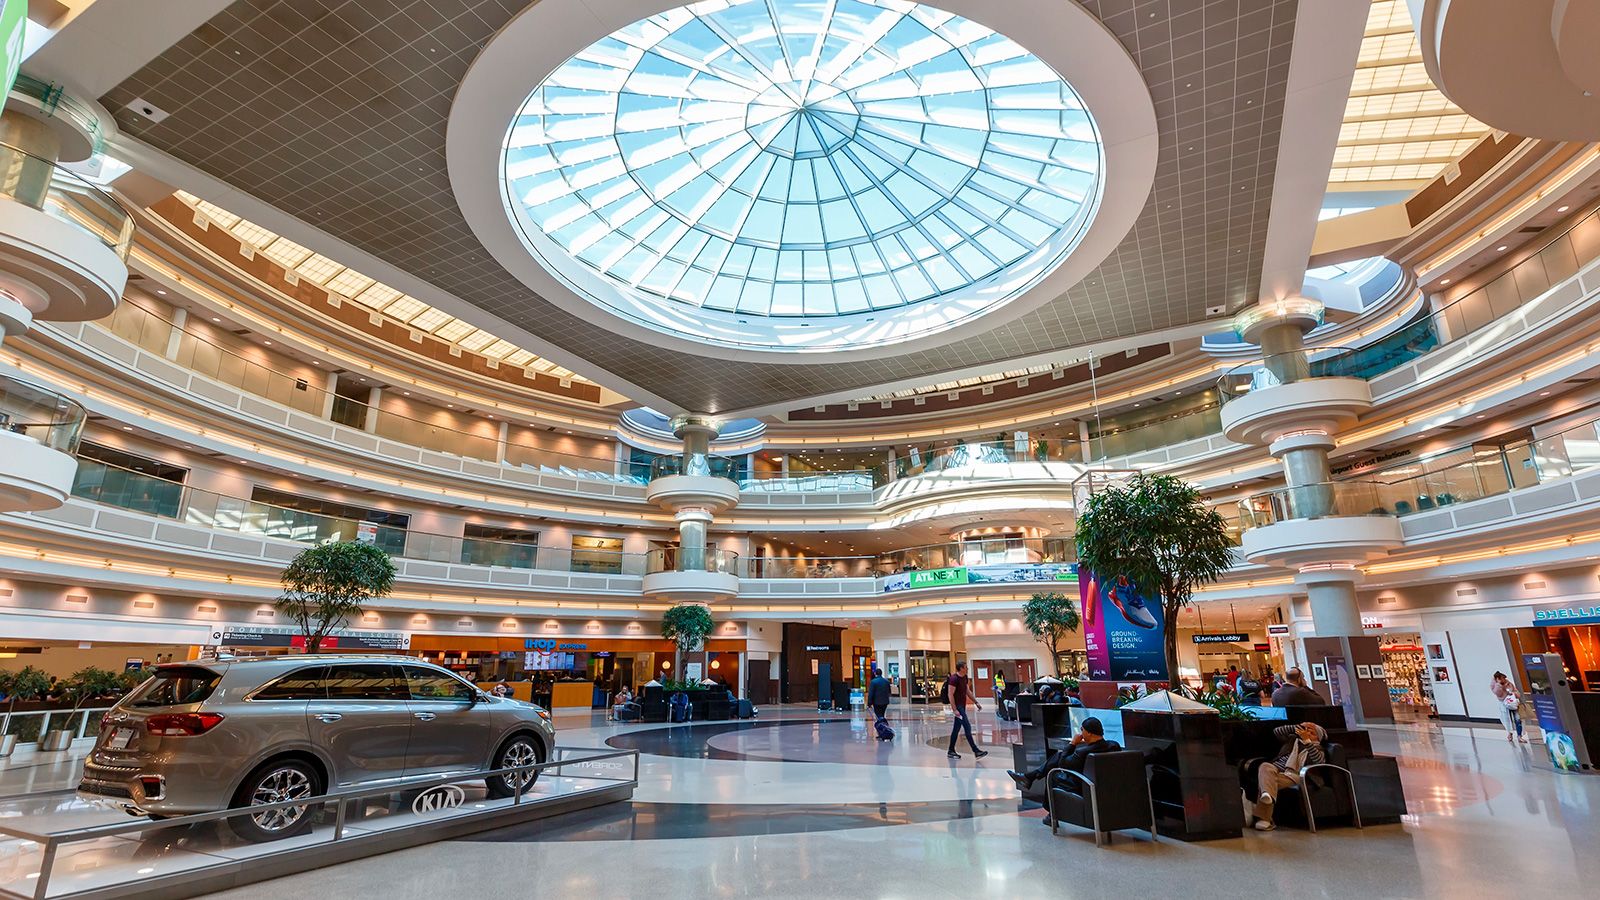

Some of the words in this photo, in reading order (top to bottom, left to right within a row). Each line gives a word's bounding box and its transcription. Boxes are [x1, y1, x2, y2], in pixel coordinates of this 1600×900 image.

[1354, 459, 1376, 469] Guest
[1376, 449, 1411, 463] Relations
[229, 627, 297, 635] DOMESTIC
[421, 790, 457, 813] KIA
